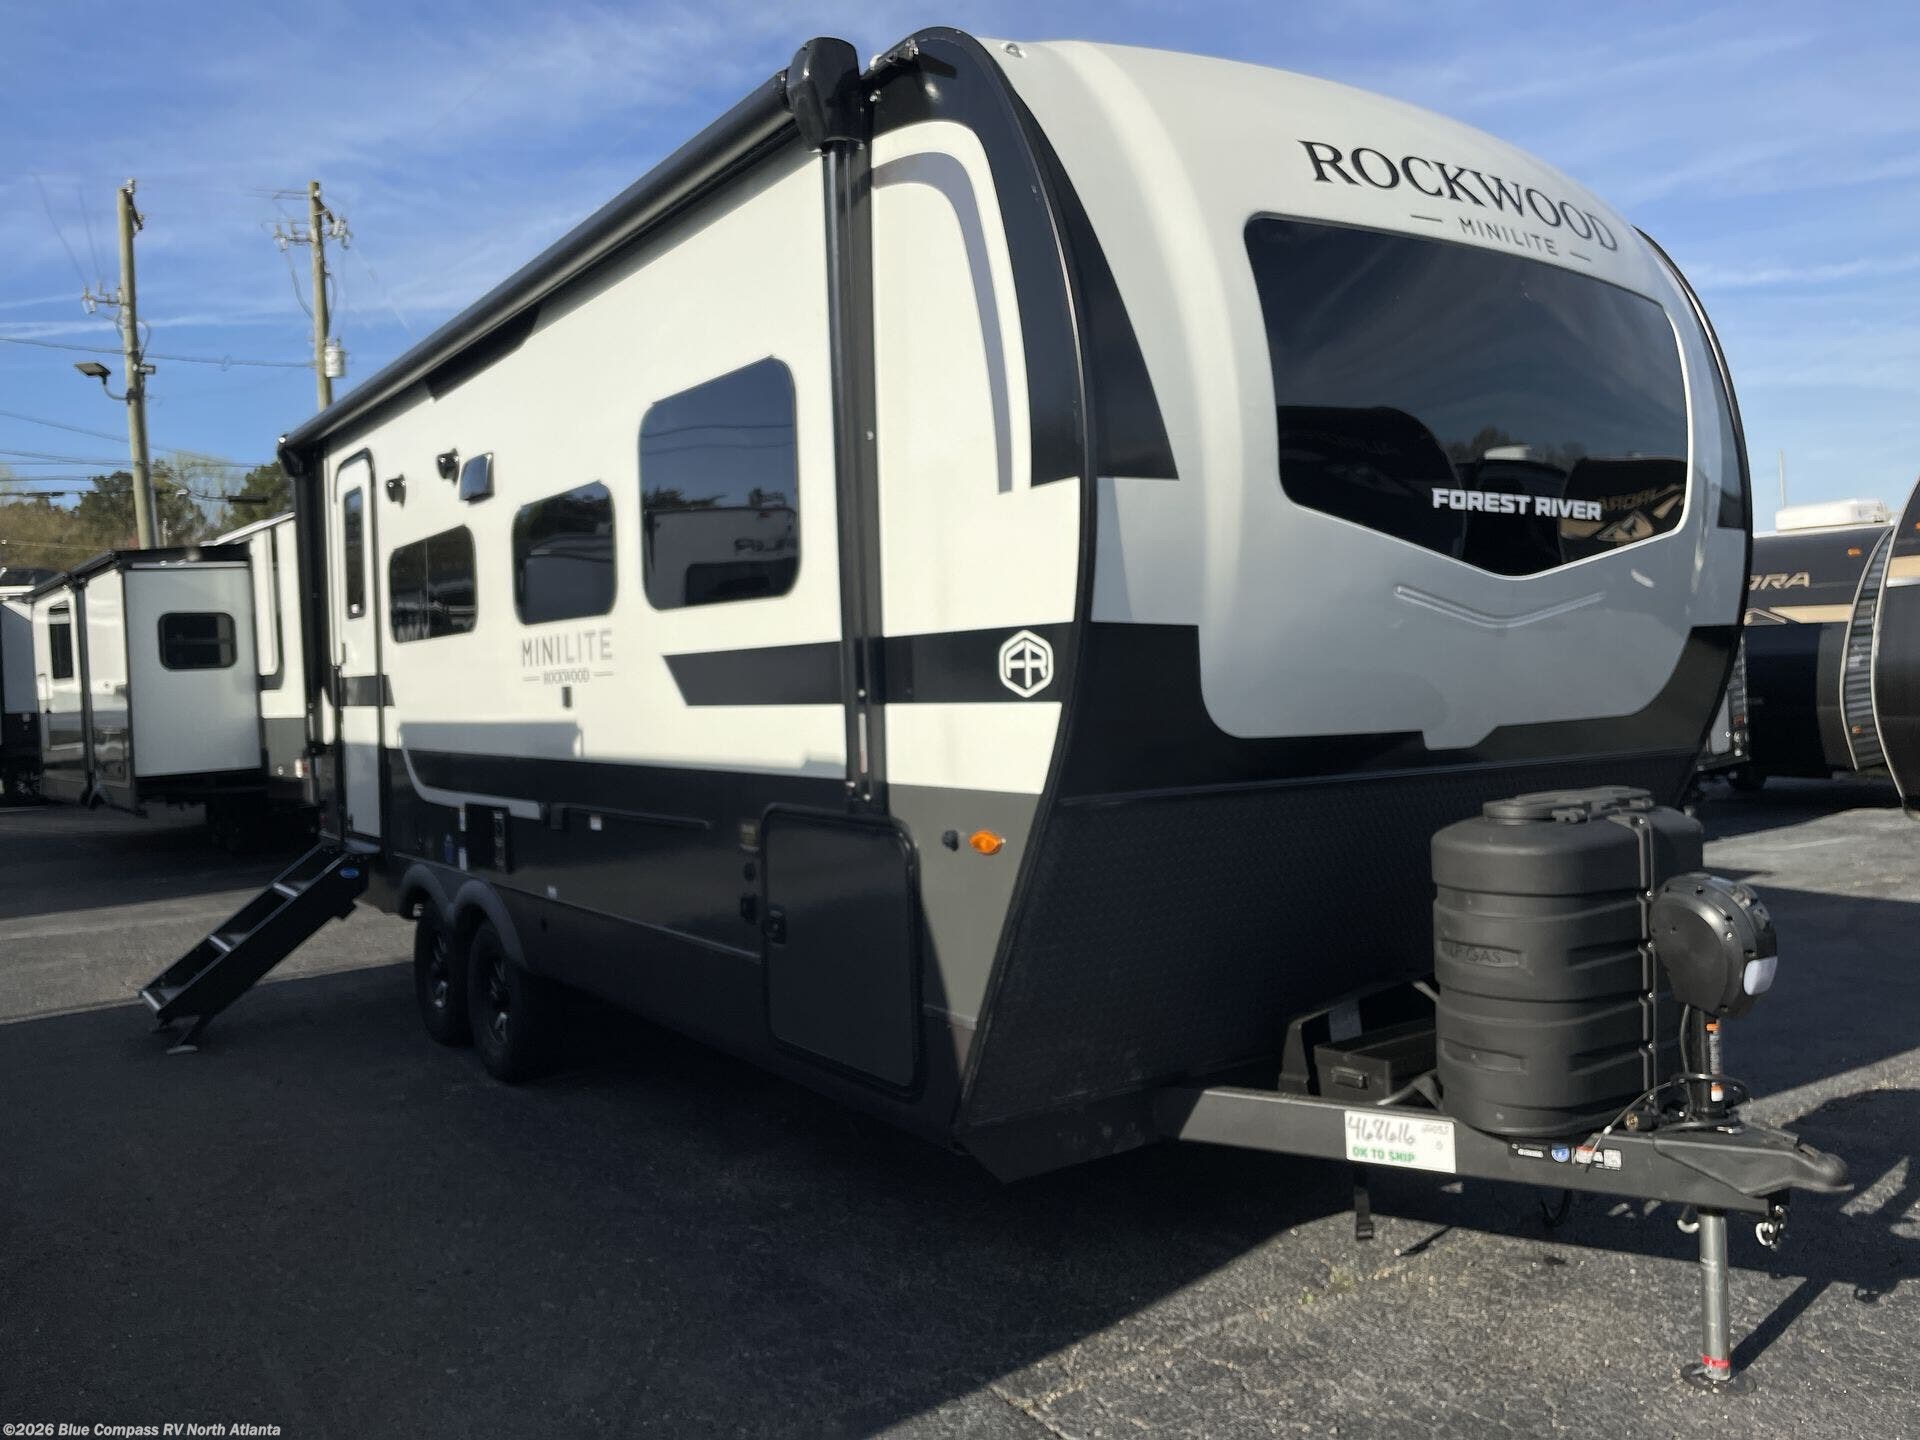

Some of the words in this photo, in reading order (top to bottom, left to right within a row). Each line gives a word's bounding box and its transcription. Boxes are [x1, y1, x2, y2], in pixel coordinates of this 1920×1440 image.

[1297, 139, 1618, 251] ROCKWOOD
[1458, 216, 1559, 256] MINILITE
[1432, 488, 1531, 515] FOREST
[1534, 496, 1601, 520] RIVER
[522, 629, 613, 667] MINILITE
[543, 668, 590, 685] ROCKWOOD
[1352, 1146, 1368, 1157] OK
[1371, 1148, 1385, 1160] TO
[1388, 1151, 1416, 1162] SHIP
